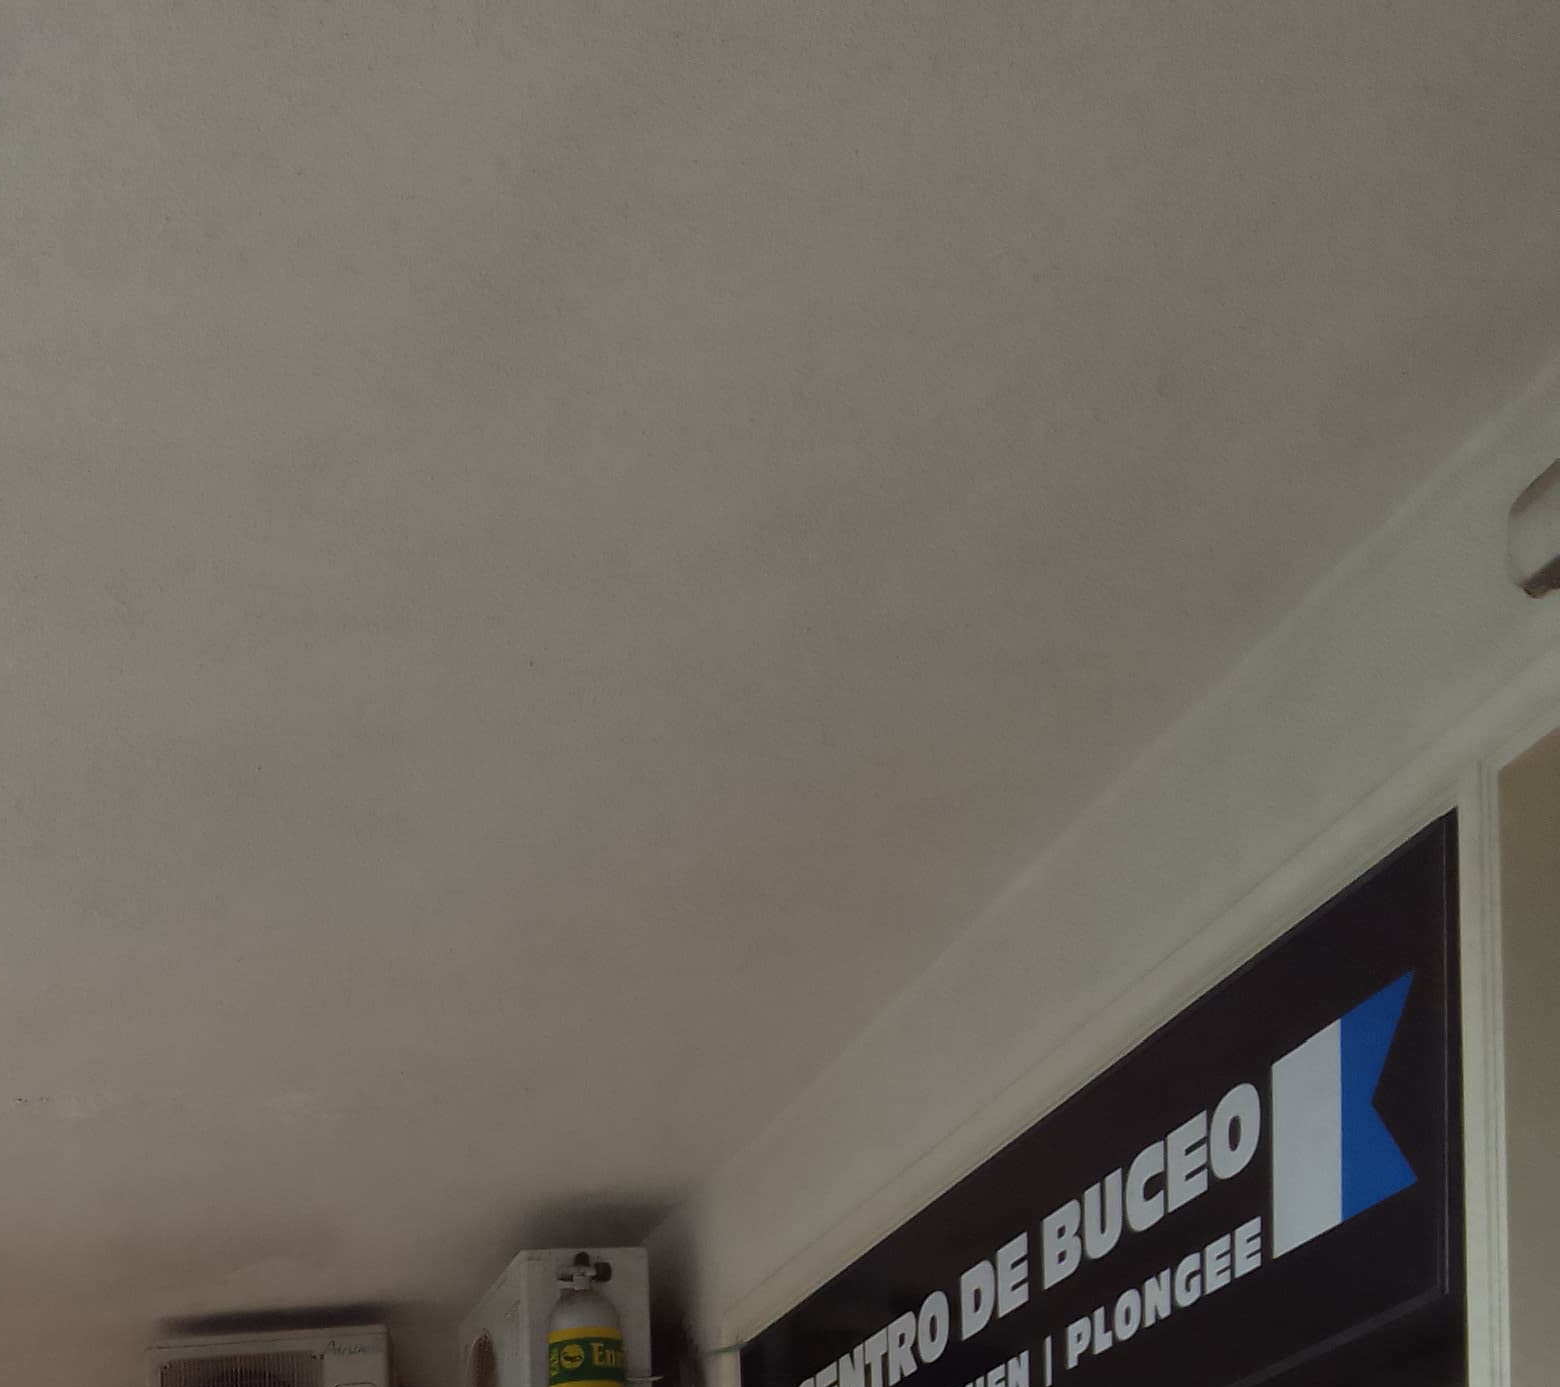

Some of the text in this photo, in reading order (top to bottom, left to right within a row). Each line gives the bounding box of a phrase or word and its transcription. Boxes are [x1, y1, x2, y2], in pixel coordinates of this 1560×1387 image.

[960, 1231, 1029, 1341] DE
[1041, 1083, 1261, 1290] BUCEO
[1066, 1216, 1262, 1369] PLONGEE
